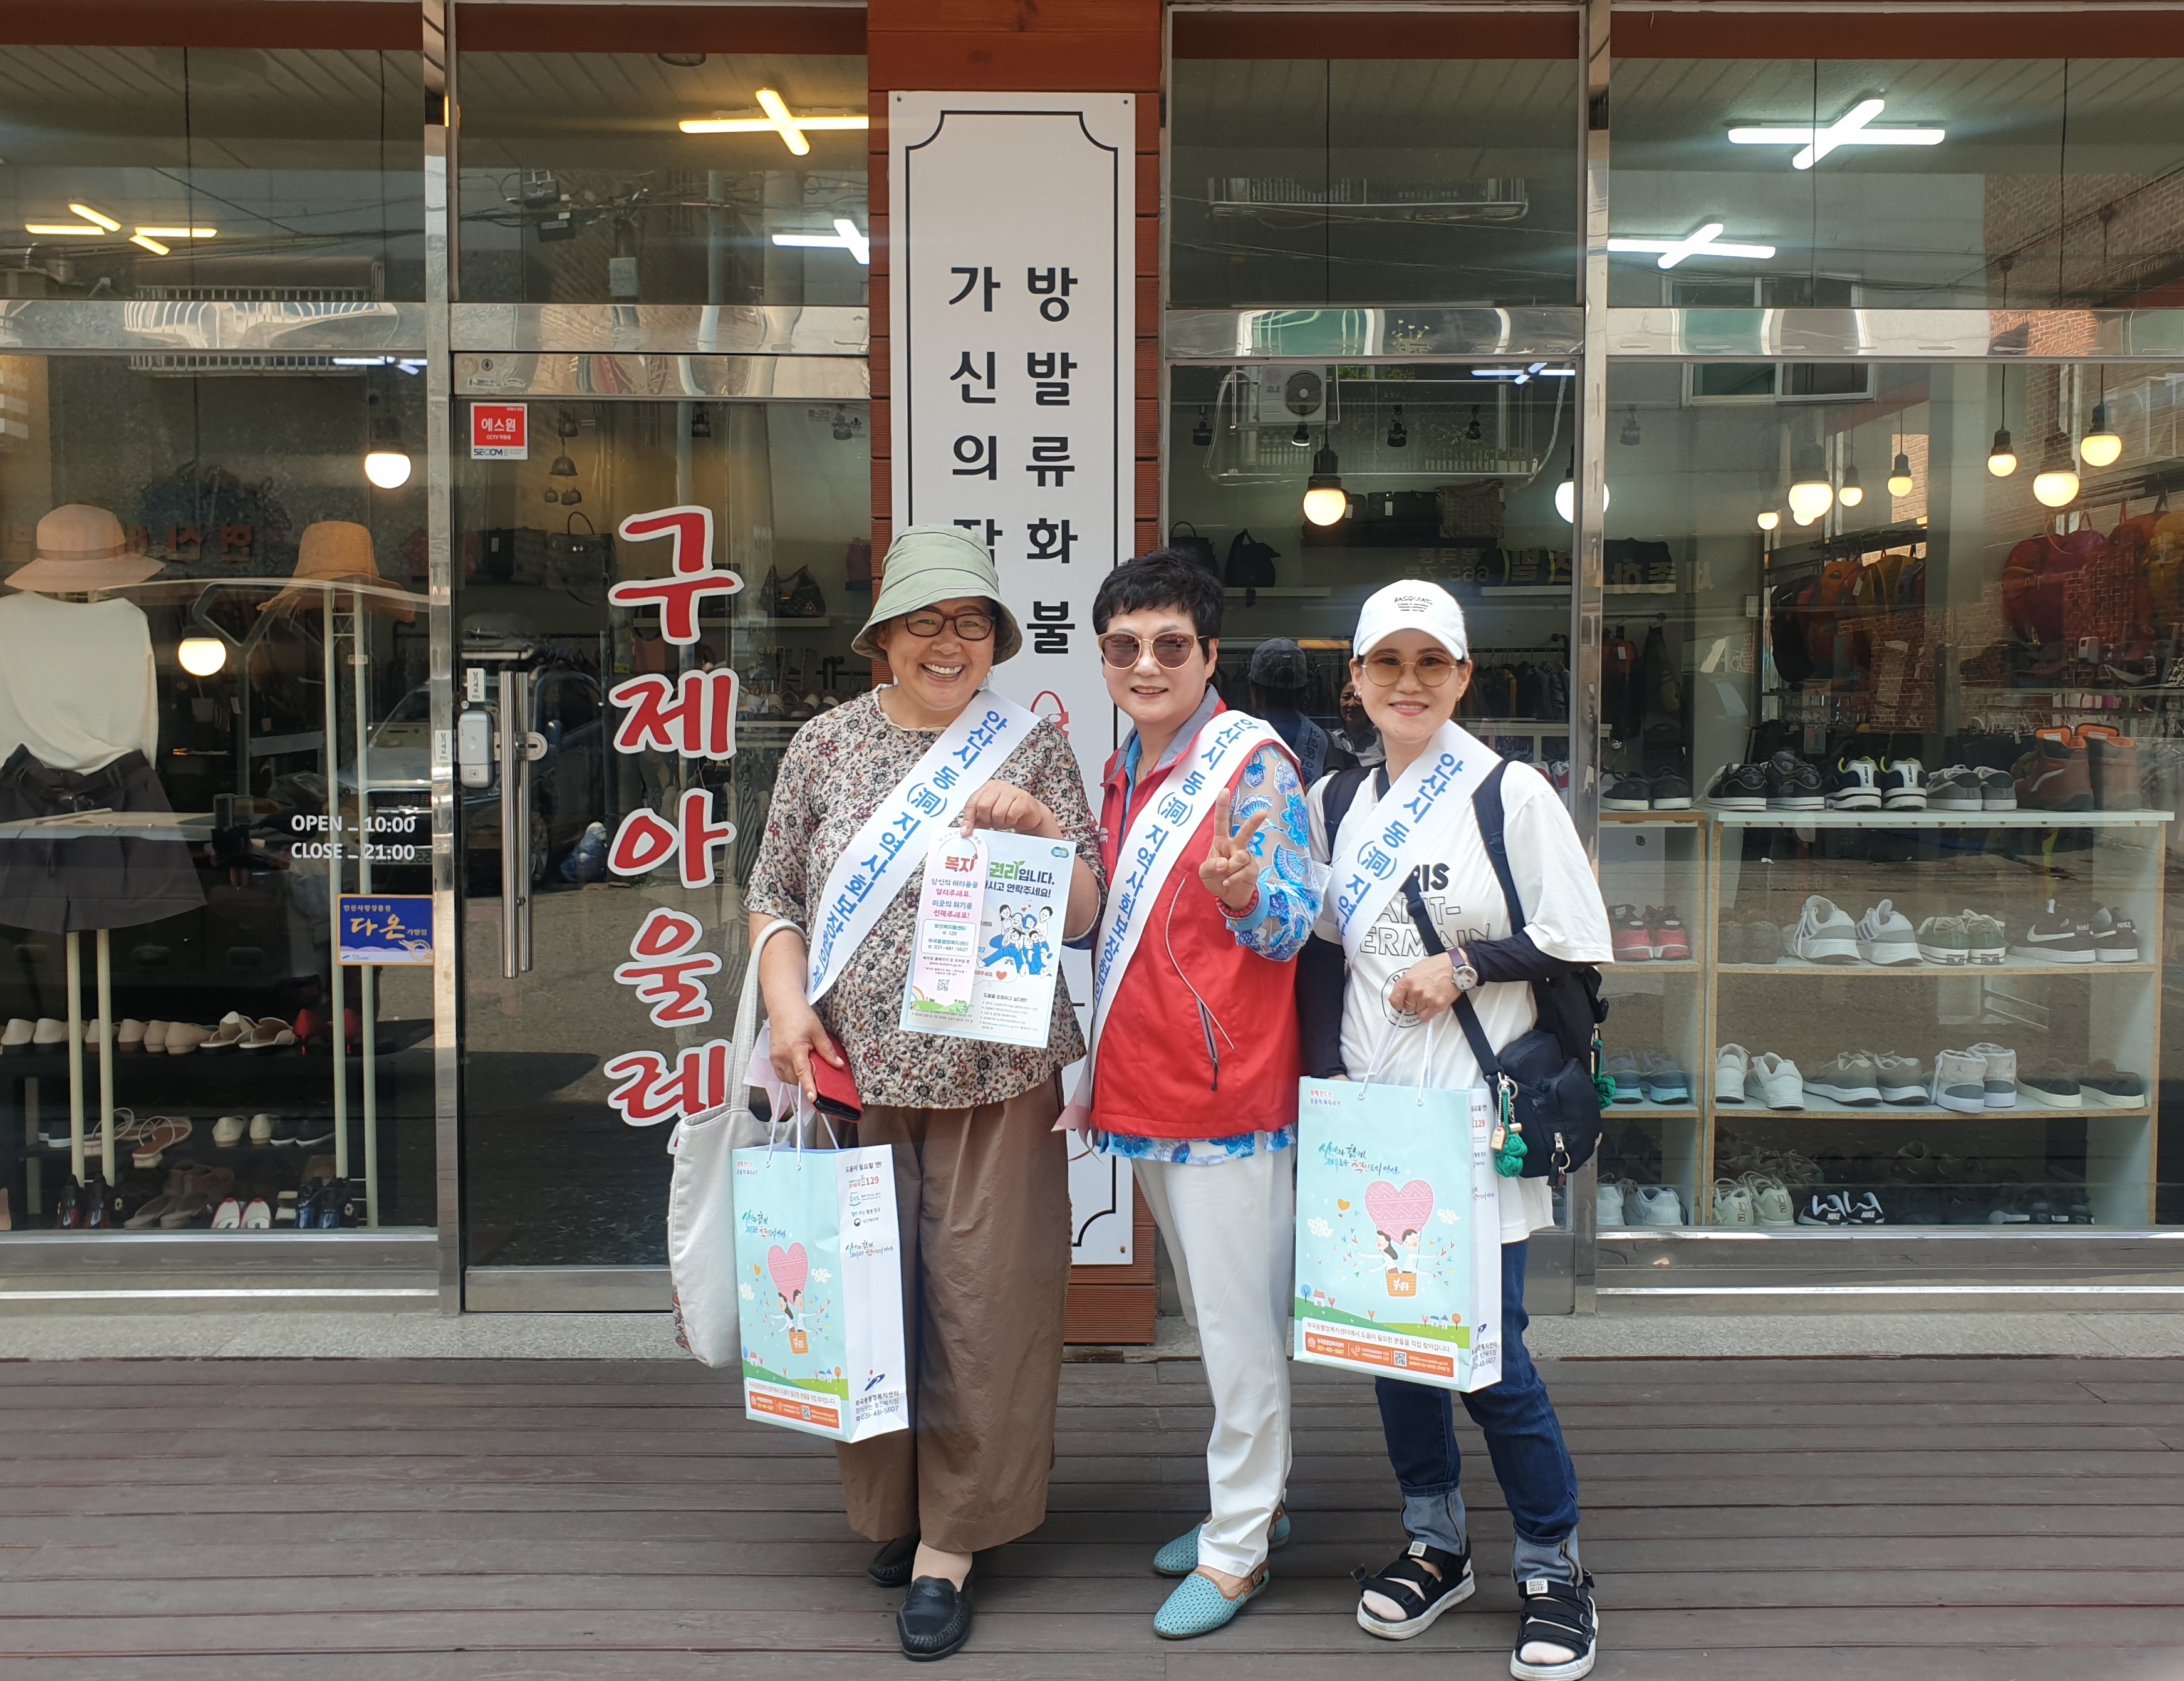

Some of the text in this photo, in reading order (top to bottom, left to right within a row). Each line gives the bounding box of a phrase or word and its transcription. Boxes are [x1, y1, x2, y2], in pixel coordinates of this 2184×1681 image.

[949, 266, 1078, 322] 가방
[950, 351, 1077, 405] 신발
[481, 418, 516, 432] 에스원
[952, 435, 1075, 487] 의류
[1394, 596, 1433, 605] BASQUIAT
[953, 710, 1008, 769] 안산시
[1201, 718, 1258, 771] 안산시
[907, 766, 959, 817] 동(洞)
[1158, 772, 1205, 827] 동(洞)
[1403, 753, 1464, 823] 안산시
[291, 814, 343, 831] OPEN
[365, 816, 415, 833] 10:00
[291, 843, 343, 858] CLOSE
[363, 844, 415, 860] 21:00
[1357, 820, 1410, 880] 동(洞)
[945, 854, 1054, 885] 복지 권리입니다.
[813, 812, 921, 992] 지역사회보장협의체
[936, 888, 971, 897] 알려주세요.
[1007, 883, 1051, 898] 연락주세요!
[350, 913, 405, 940] 다온
[1475, 1119, 1485, 1127] 129
[845, 1165, 858, 1173] 도움이
[866, 1176, 880, 1185] 129
[1308, 1322, 1452, 1353] 부곡동행정복지센터에서 도움이 필요한 분들을 직접 찾아갑니다.
[856, 1390, 898, 1406] 부곡동행정복지센터
[875, 1398, 898, 1408] 보건복지팀
